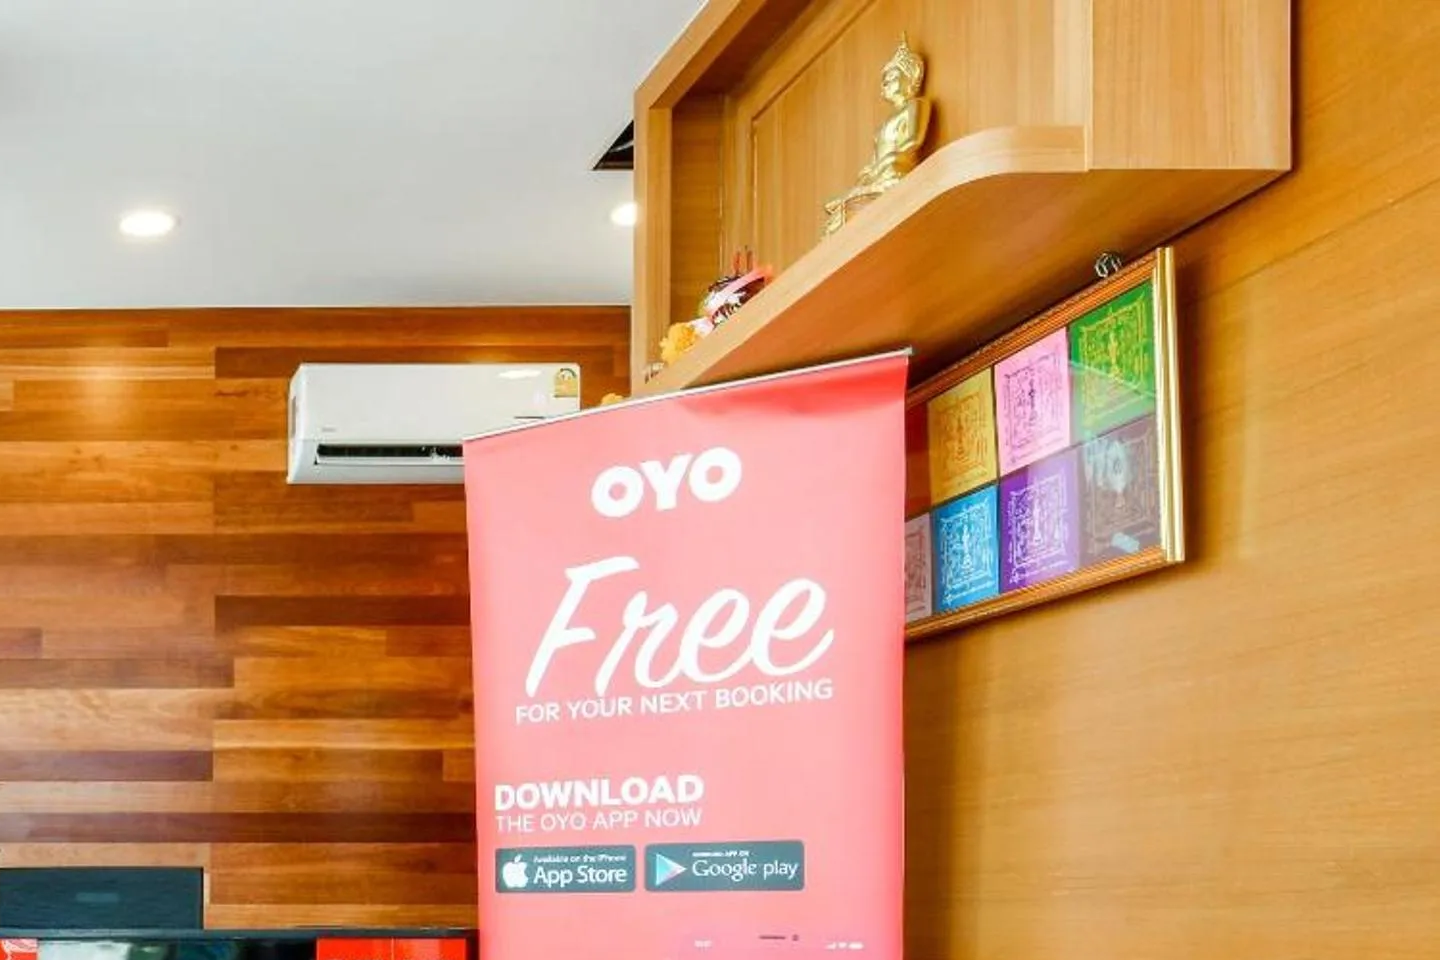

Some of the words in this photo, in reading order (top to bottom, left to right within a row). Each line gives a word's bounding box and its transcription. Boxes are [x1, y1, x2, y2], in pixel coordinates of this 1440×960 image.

[591, 446, 743, 518] OYO
[525, 555, 835, 697] Free
[515, 701, 559, 725] FOR
[567, 696, 632, 720] YOUR
[640, 690, 707, 714] NEXT
[716, 679, 834, 710] BOOKING
[495, 774, 705, 811] DOWNLOAD
[495, 813, 534, 833] THE
[540, 811, 586, 832] OYO
[592, 809, 638, 830] APP
[645, 807, 703, 828] NOW
[533, 865, 573, 888] App
[576, 865, 628, 884] Store
[692, 857, 757, 882] Google
[763, 859, 799, 881] play
